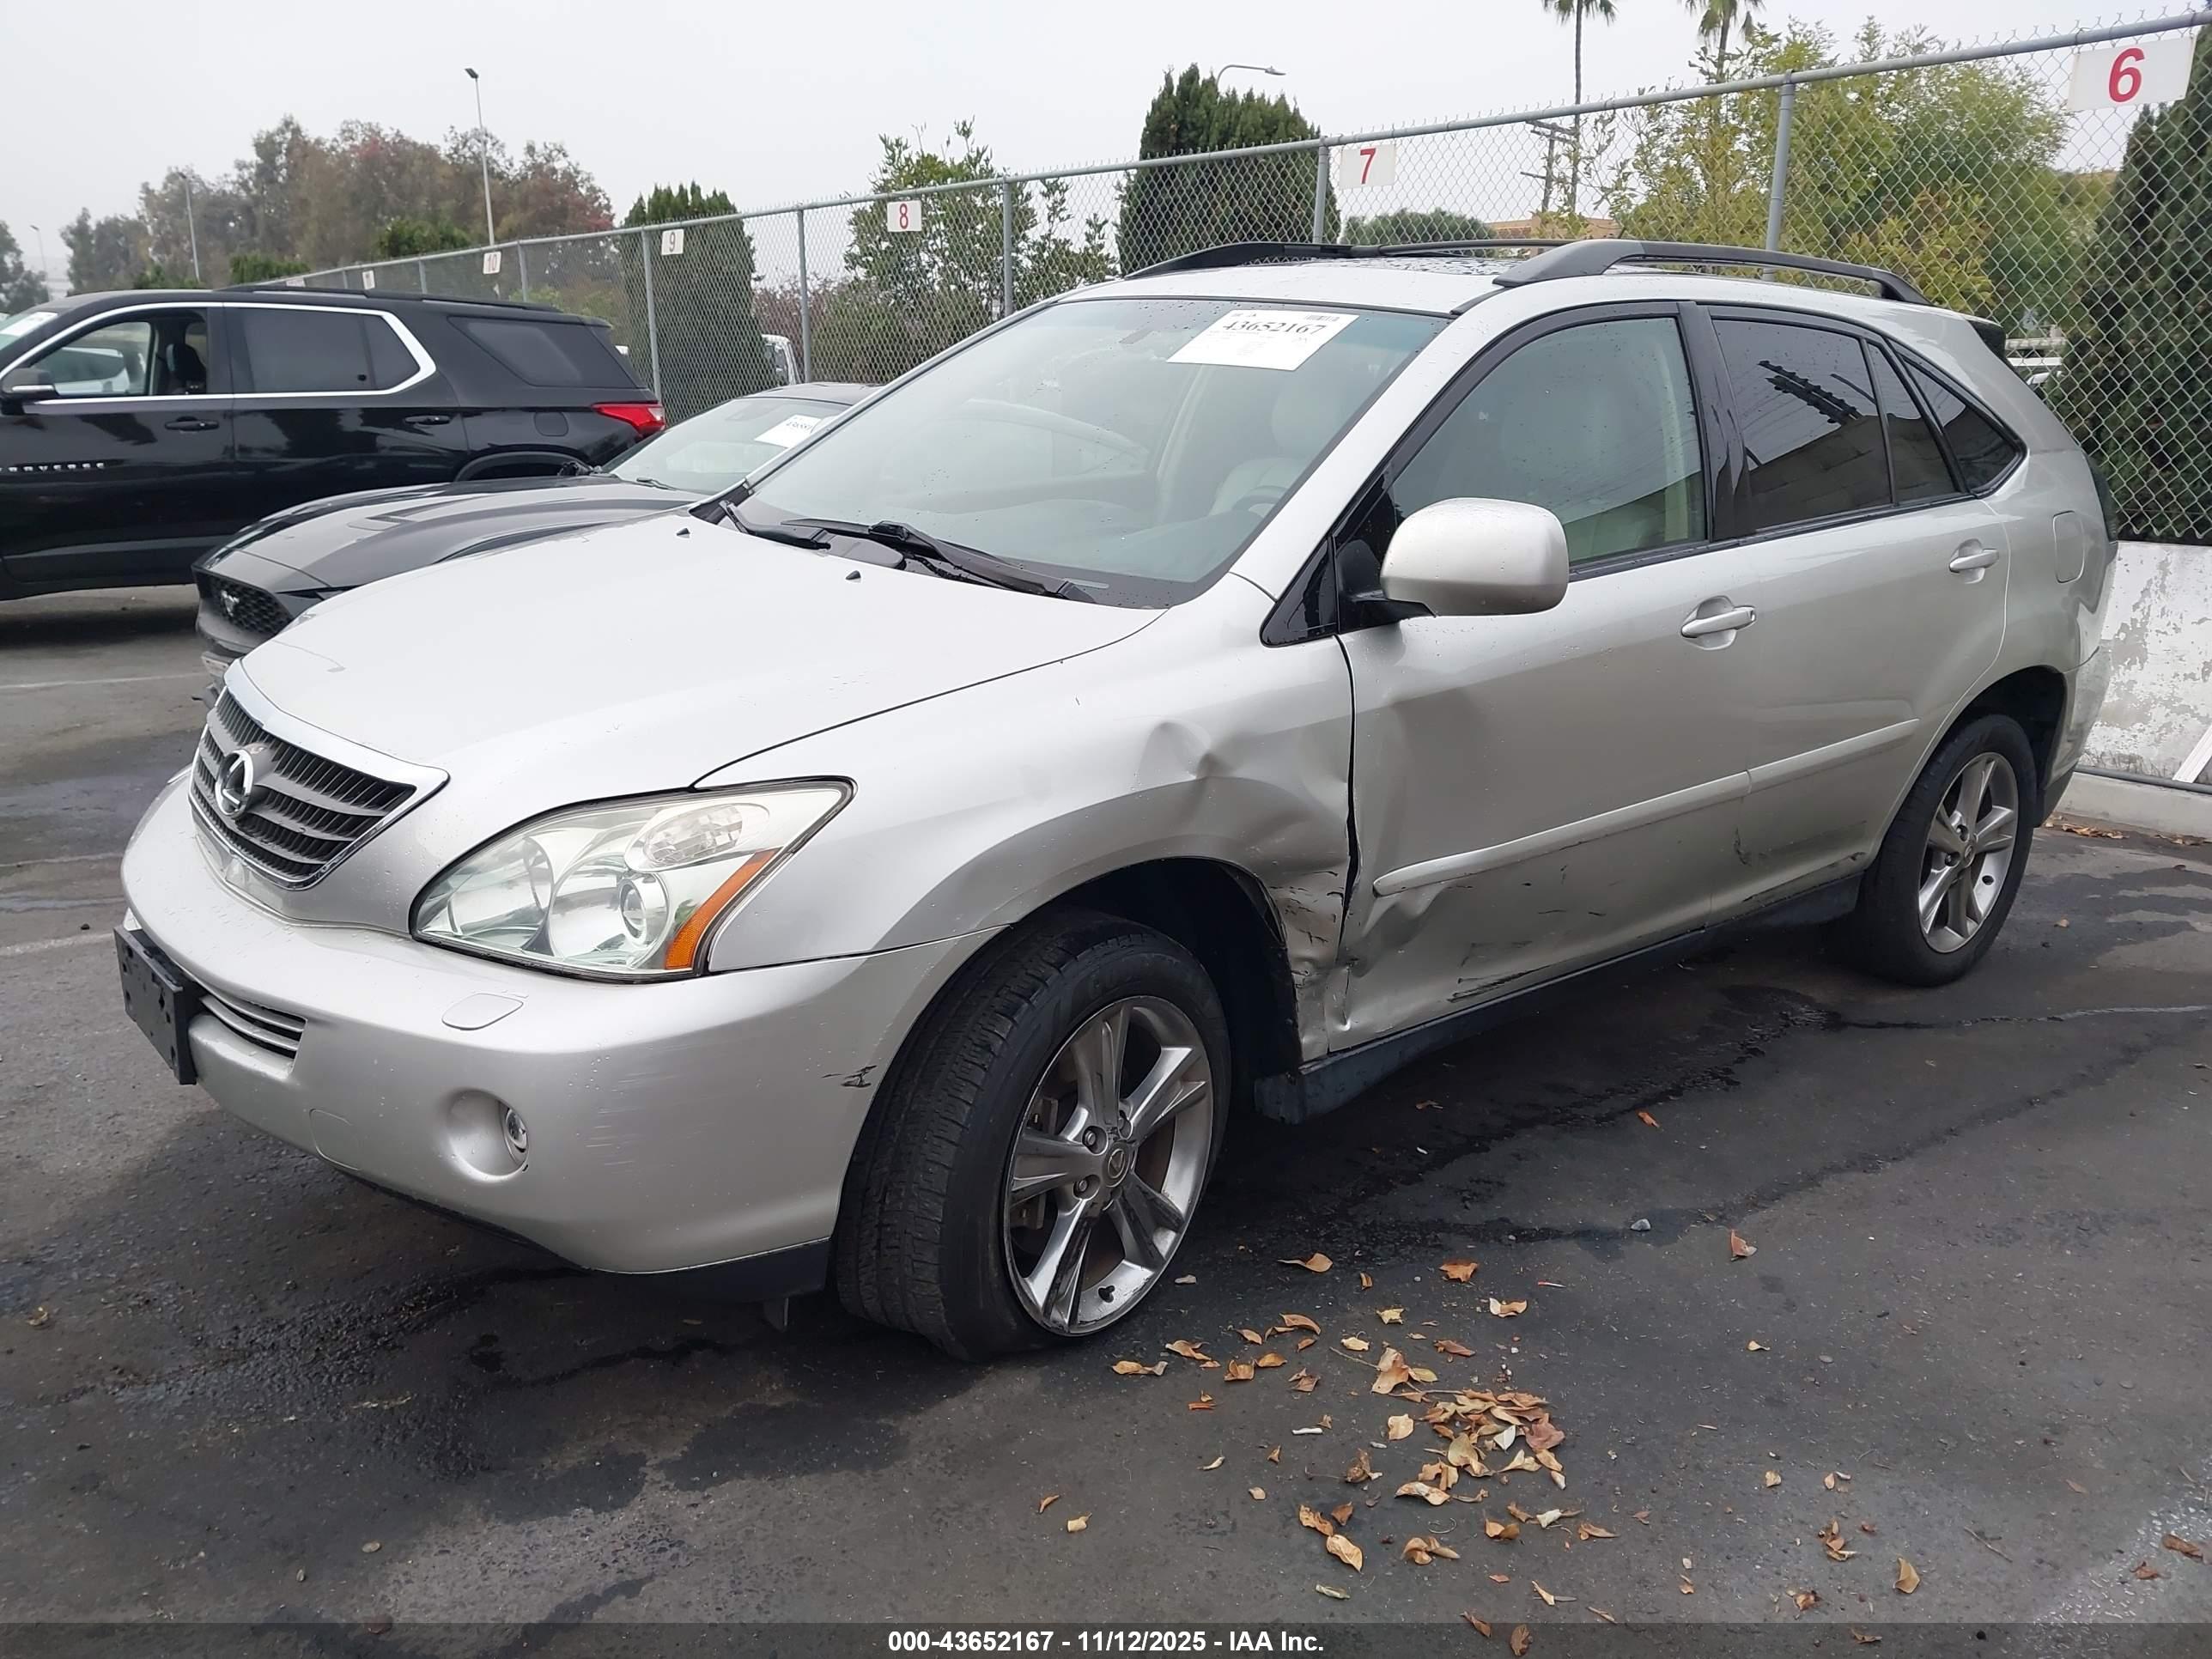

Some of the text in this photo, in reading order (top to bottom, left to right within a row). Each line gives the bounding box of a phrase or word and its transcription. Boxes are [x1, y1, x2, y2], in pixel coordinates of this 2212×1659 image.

[2108, 47, 2145, 103] 6
[1359, 148, 1377, 185] 7
[899, 203, 908, 230] 8
[669, 231, 676, 252] 9
[487, 253, 498, 272] 10
[1223, 320, 1327, 334] 43652167
[0, 462, 105, 473] RAVERSE
